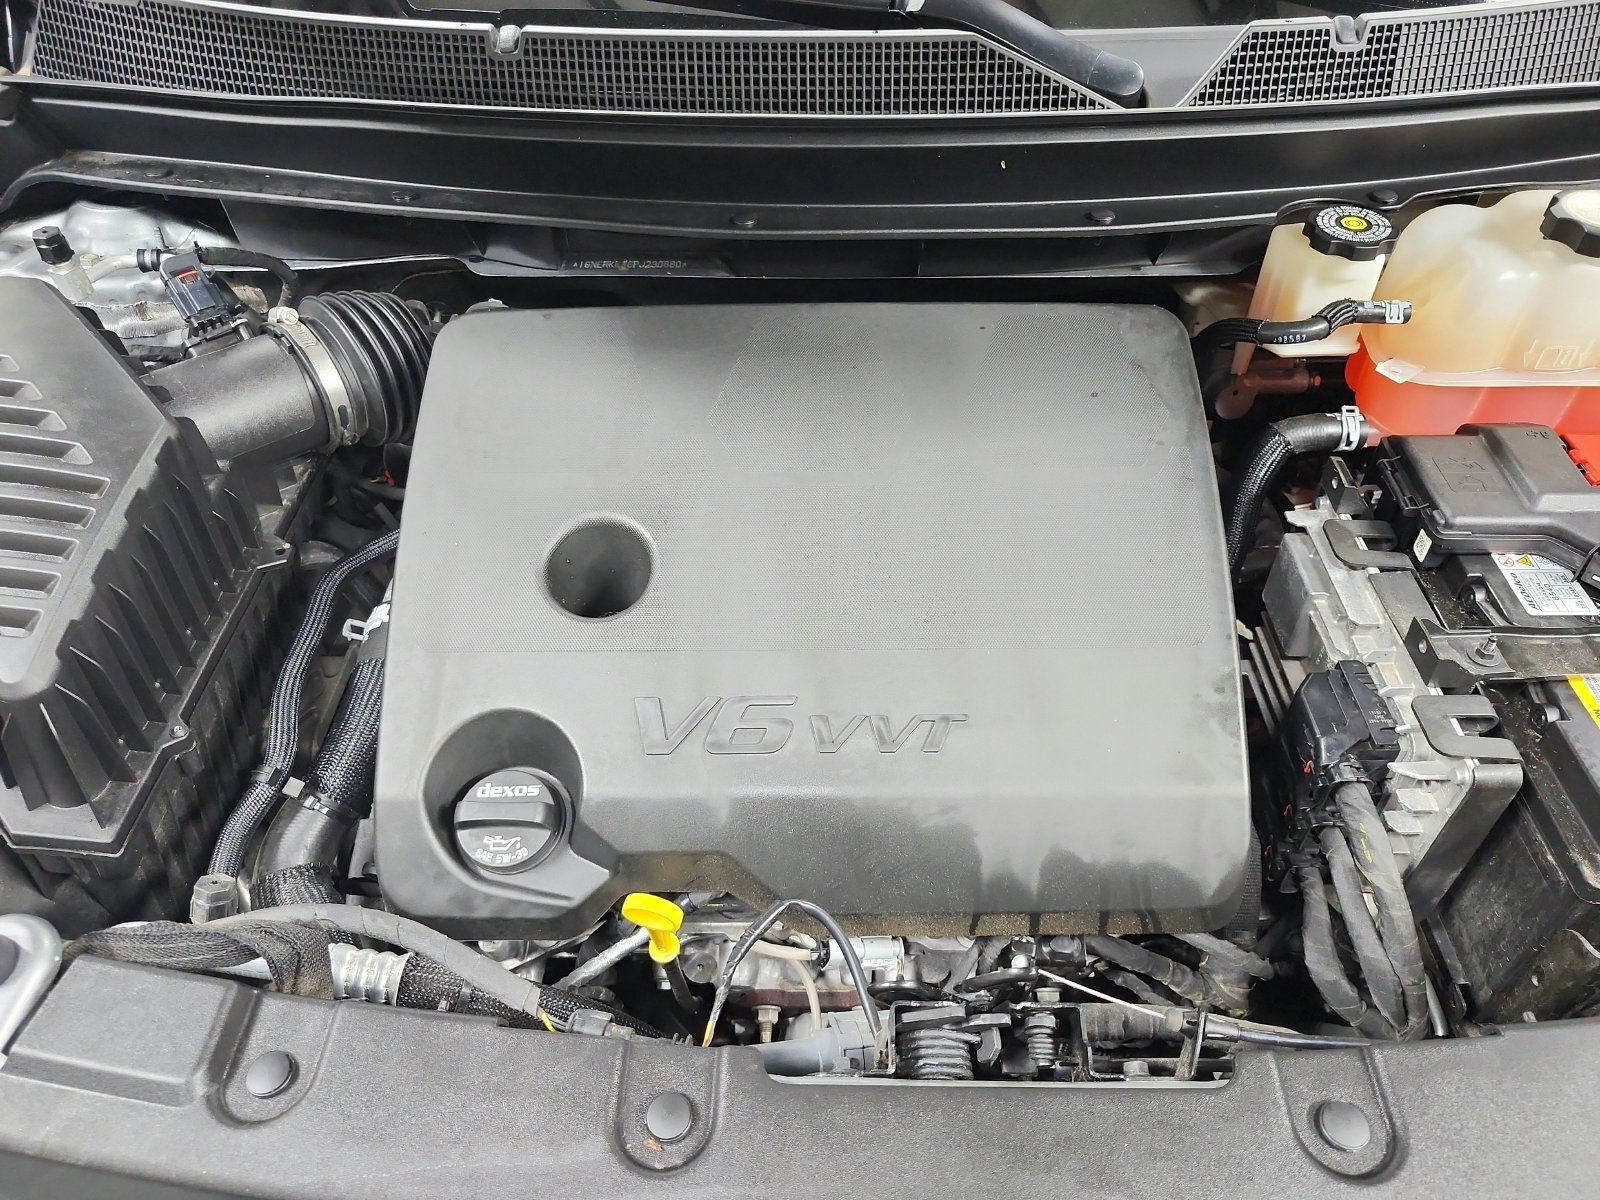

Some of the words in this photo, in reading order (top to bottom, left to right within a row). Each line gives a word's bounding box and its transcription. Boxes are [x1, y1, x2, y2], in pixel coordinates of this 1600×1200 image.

[635, 695, 799, 755] V6
[809, 714, 970, 754] VVT
[476, 782, 543, 798] dexos
[475, 848, 494, 863] SAE
[495, 847, 529, 864] 5W-30
